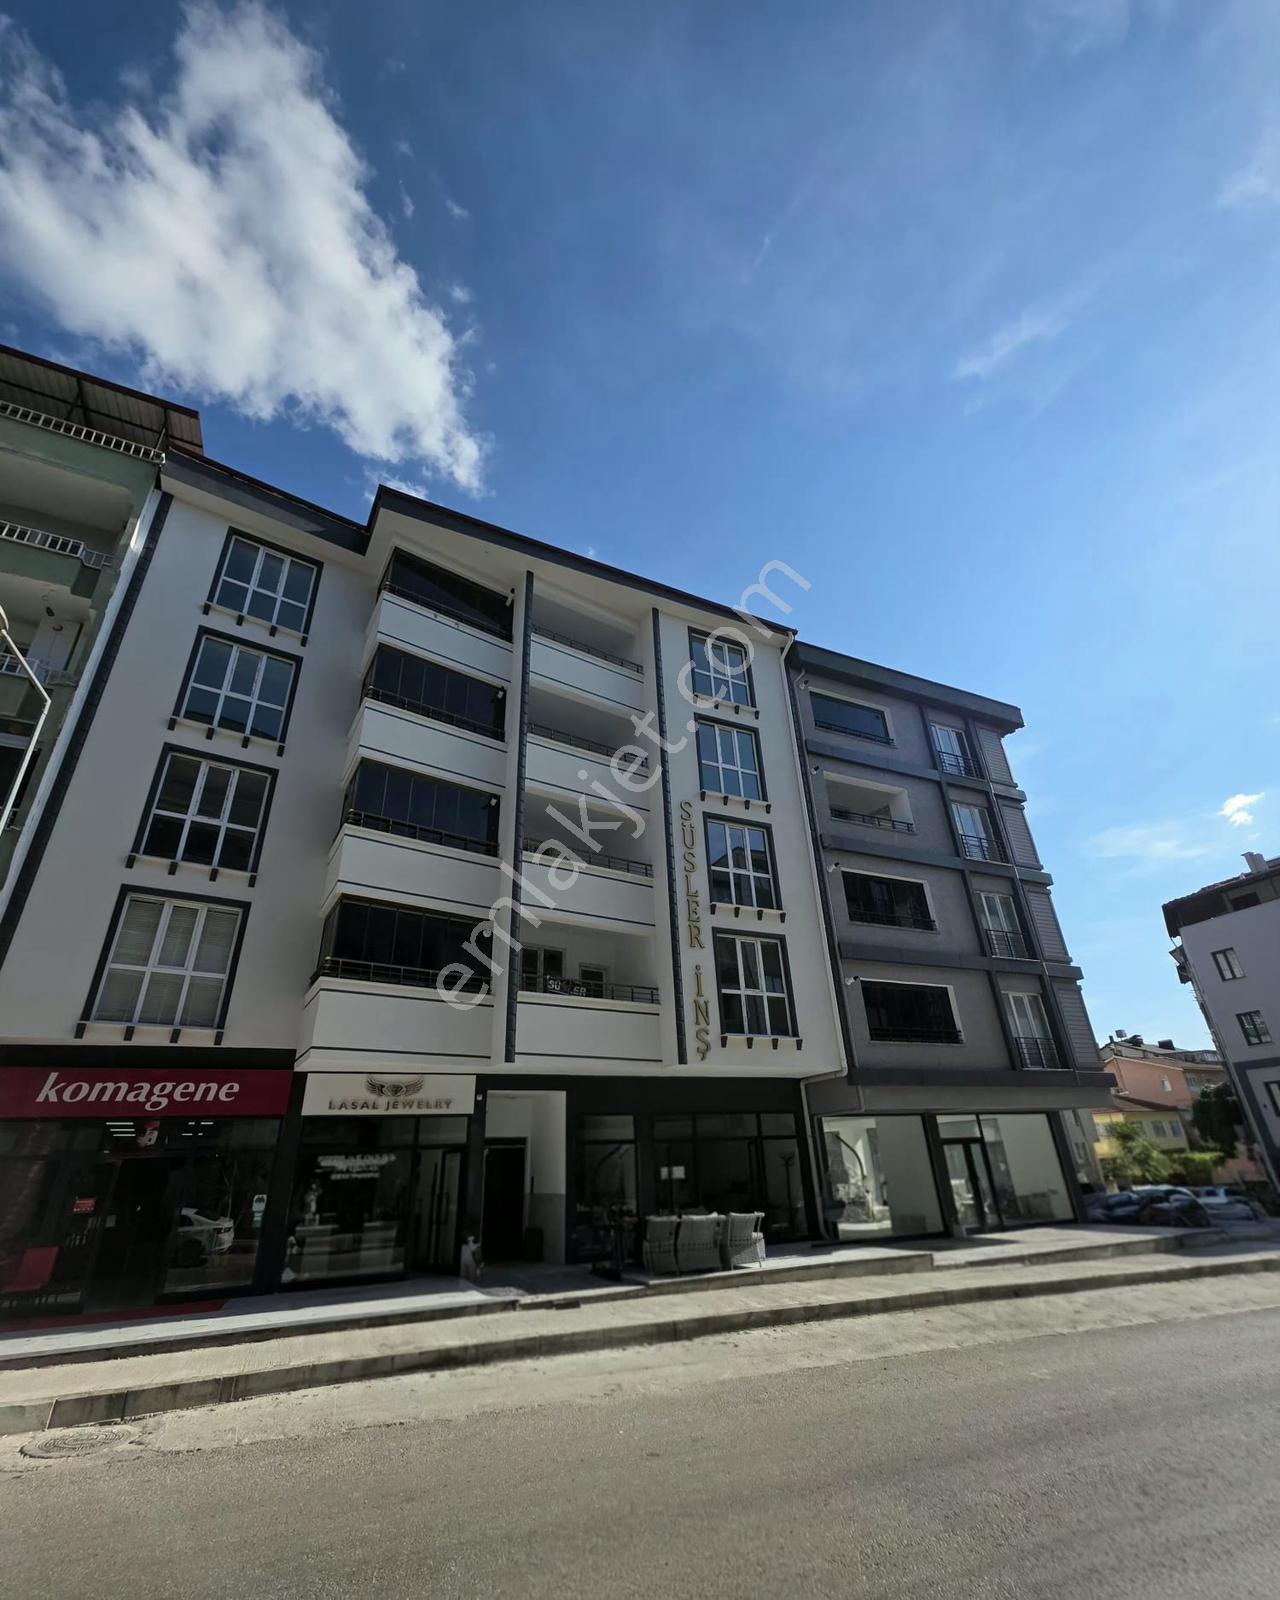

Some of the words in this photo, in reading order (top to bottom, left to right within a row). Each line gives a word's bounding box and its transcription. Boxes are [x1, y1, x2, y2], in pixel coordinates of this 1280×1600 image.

[680, 801, 705, 950] SÜSLER
[35, 1072, 240, 1111] komagene
[328, 1099, 379, 1111] LASAL
[384, 1099, 453, 1112] JEWELRY
